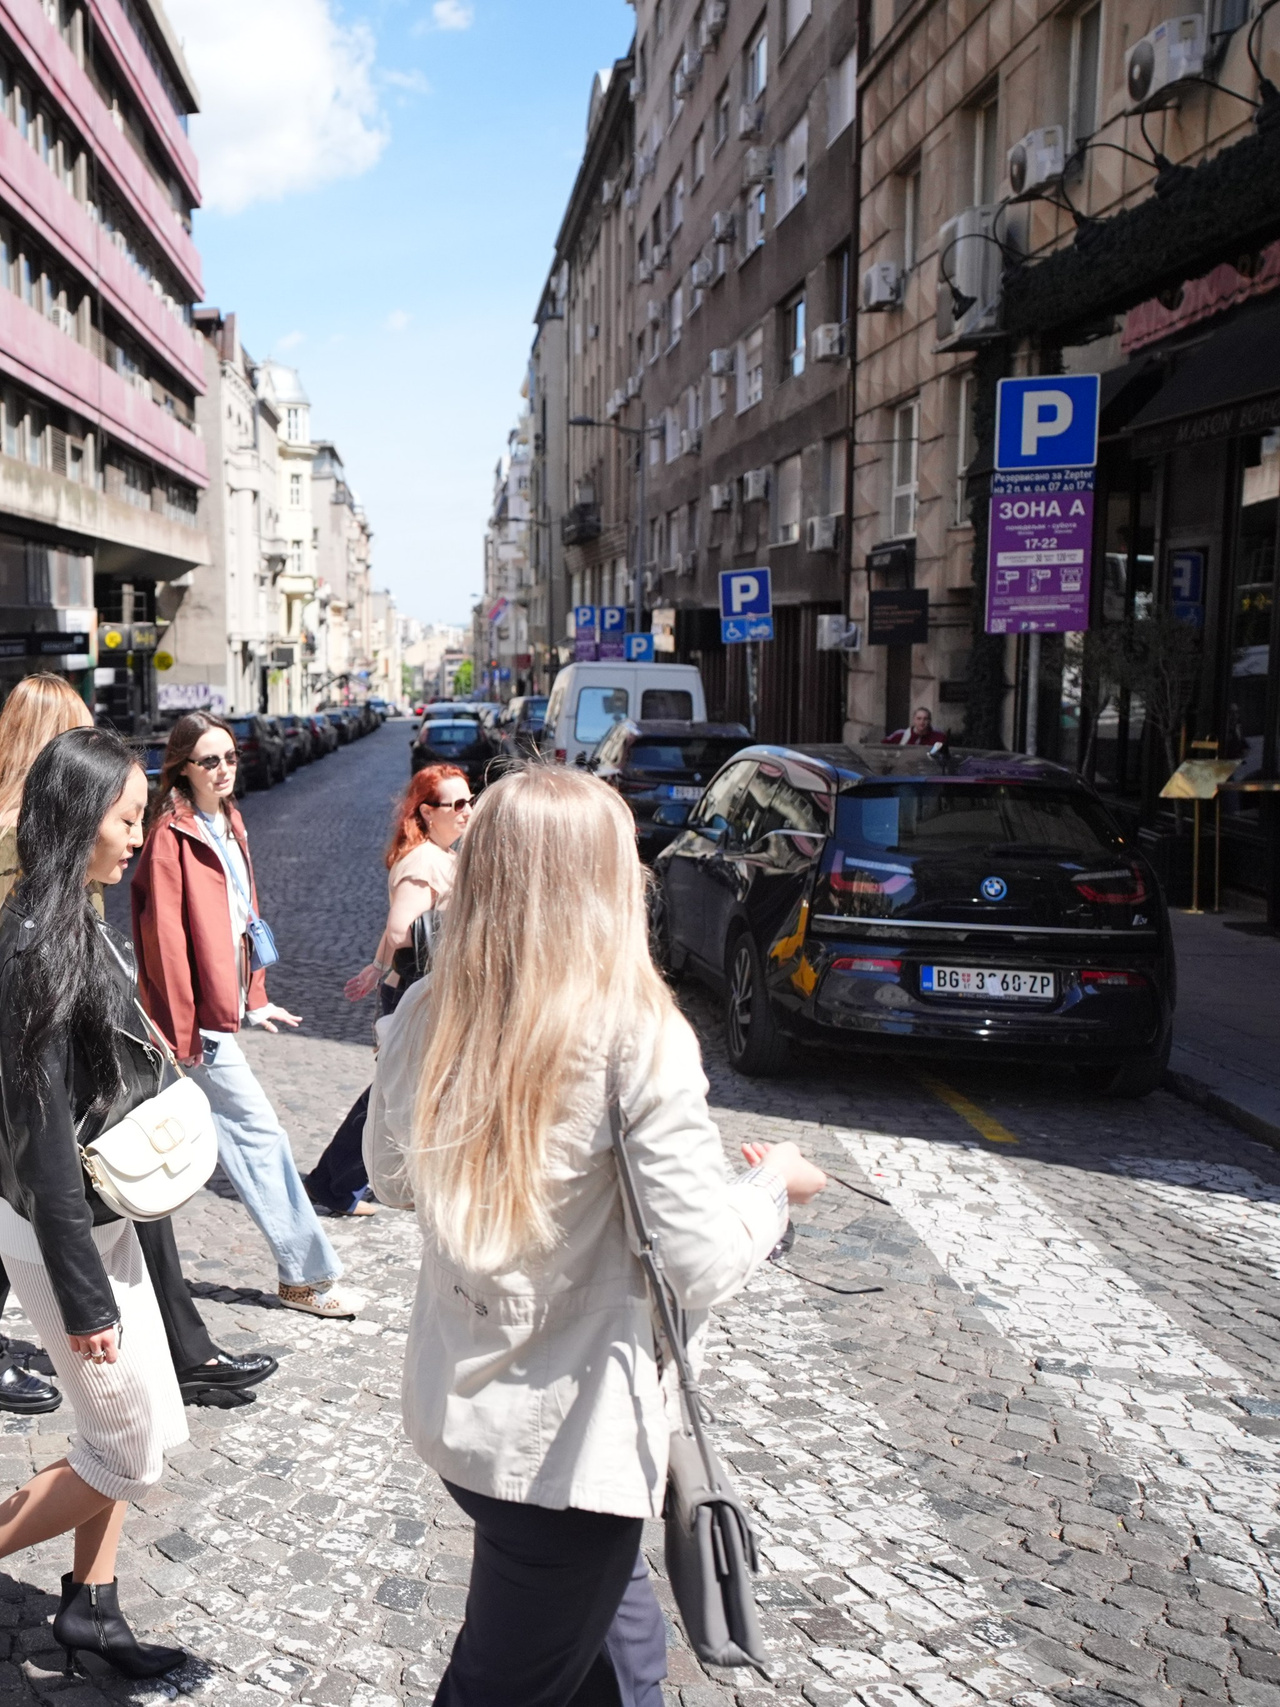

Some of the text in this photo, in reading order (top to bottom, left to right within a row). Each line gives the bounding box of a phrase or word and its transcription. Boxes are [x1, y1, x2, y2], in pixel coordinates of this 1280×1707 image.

[1021, 390, 1073, 456] P
[994, 470, 1093, 484] Резервисано за Zepter
[993, 486, 1005, 494] на
[1006, 484, 1013, 493] 2
[1034, 483, 1047, 492] од
[1048, 482, 1061, 491] 07
[1063, 483, 1075, 492] до
[1076, 481, 1086, 490] 17
[999, 499, 1086, 519] ЗОНА А
[1024, 538, 1058, 549] 17-22
[730, 576, 760, 613] P
[578, 608, 592, 626] P
[604, 609, 620, 630] P
[631, 637, 648, 659] P
[937, 970, 959, 988] BG
